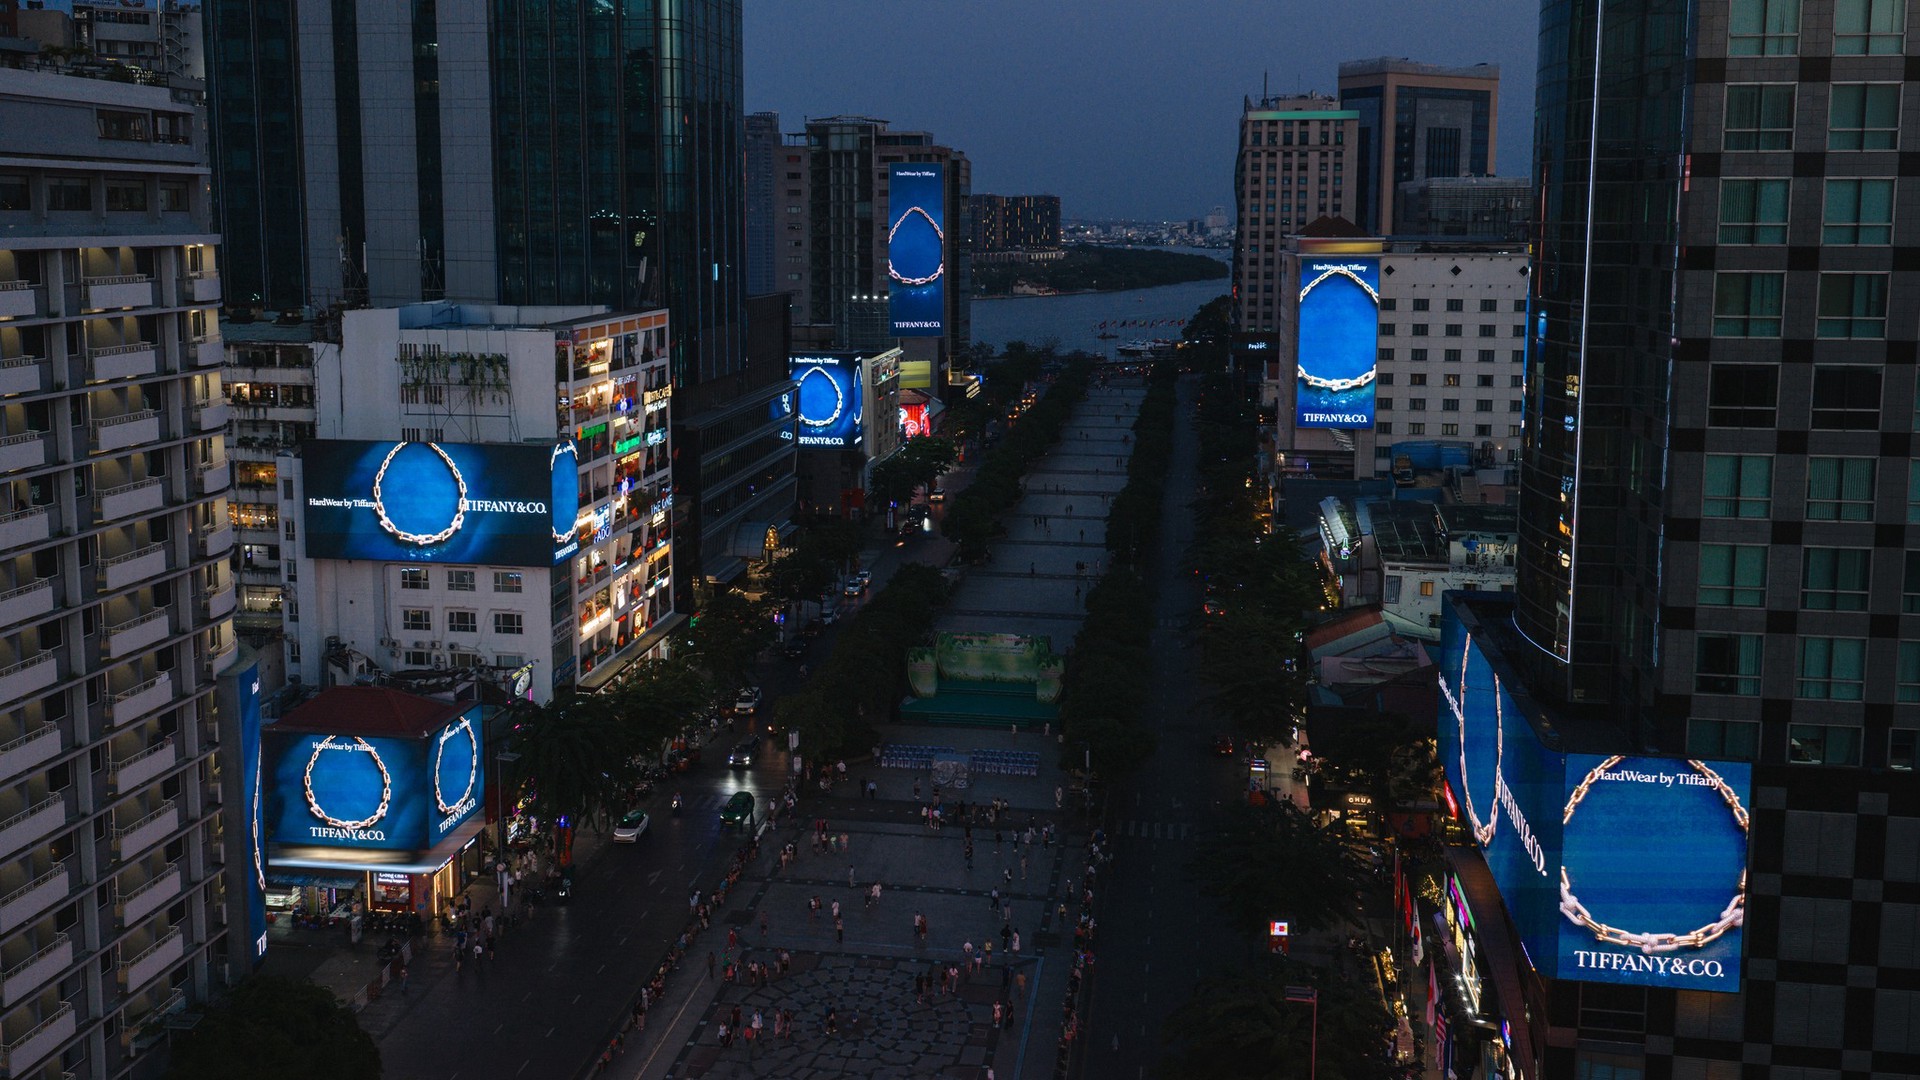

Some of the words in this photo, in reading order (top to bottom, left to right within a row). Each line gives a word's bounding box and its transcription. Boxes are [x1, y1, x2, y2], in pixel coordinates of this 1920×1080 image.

[1348, 264, 1367, 272] Tiffany
[817, 357, 823, 365] by
[1303, 413, 1367, 423] TIFFANY&CO.
[309, 498, 343, 507] HardWear
[344, 498, 352, 508] by
[353, 499, 378, 510] Tiffany
[464, 499, 547, 514] TIFFANY&CO.
[345, 743, 353, 753] by
[1594, 770, 1657, 783] HardWear
[1659, 772, 1675, 788] by
[1676, 773, 1722, 791] Tiffany
[439, 798, 476, 833] TIFFANY&CO.
[1497, 774, 1548, 877] TIFFANY&CO.
[309, 826, 385, 841] TIFFANY&CO.
[1574, 950, 1725, 978] TIFFANY&CO.
